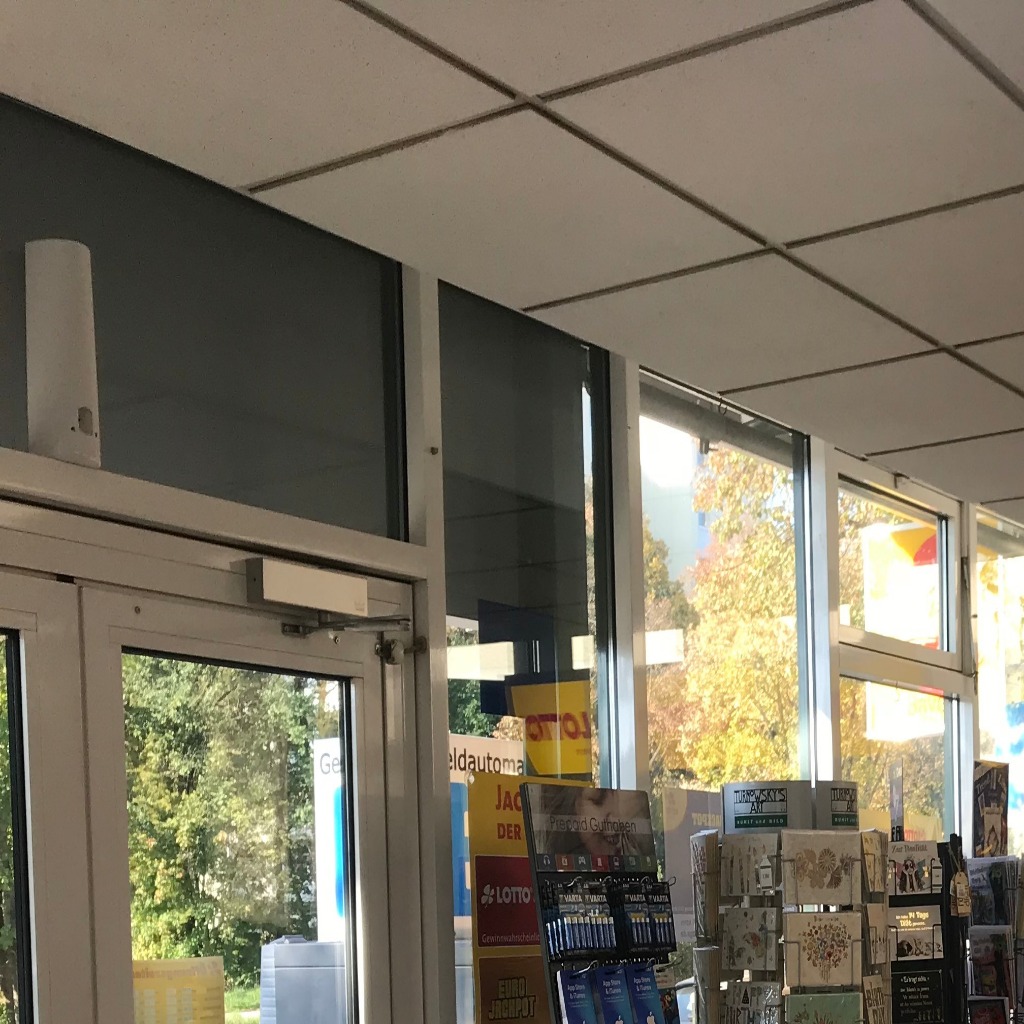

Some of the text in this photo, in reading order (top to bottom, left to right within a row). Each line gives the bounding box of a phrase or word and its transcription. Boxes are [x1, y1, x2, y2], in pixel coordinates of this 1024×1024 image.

[734, 788, 787, 803] TURNOWSKY'S
[750, 801, 763, 814] ART
[497, 822, 522, 840] DER
[550, 816, 637, 834] Prepaid Guthaben
[496, 886, 532, 905] LOTTO
[564, 894, 583, 903] VARTA
[590, 894, 608, 902] VARTA
[630, 894, 646, 902] VARTA
[653, 895, 669, 903] VARTA
[488, 995, 537, 1021] JACKPOT
